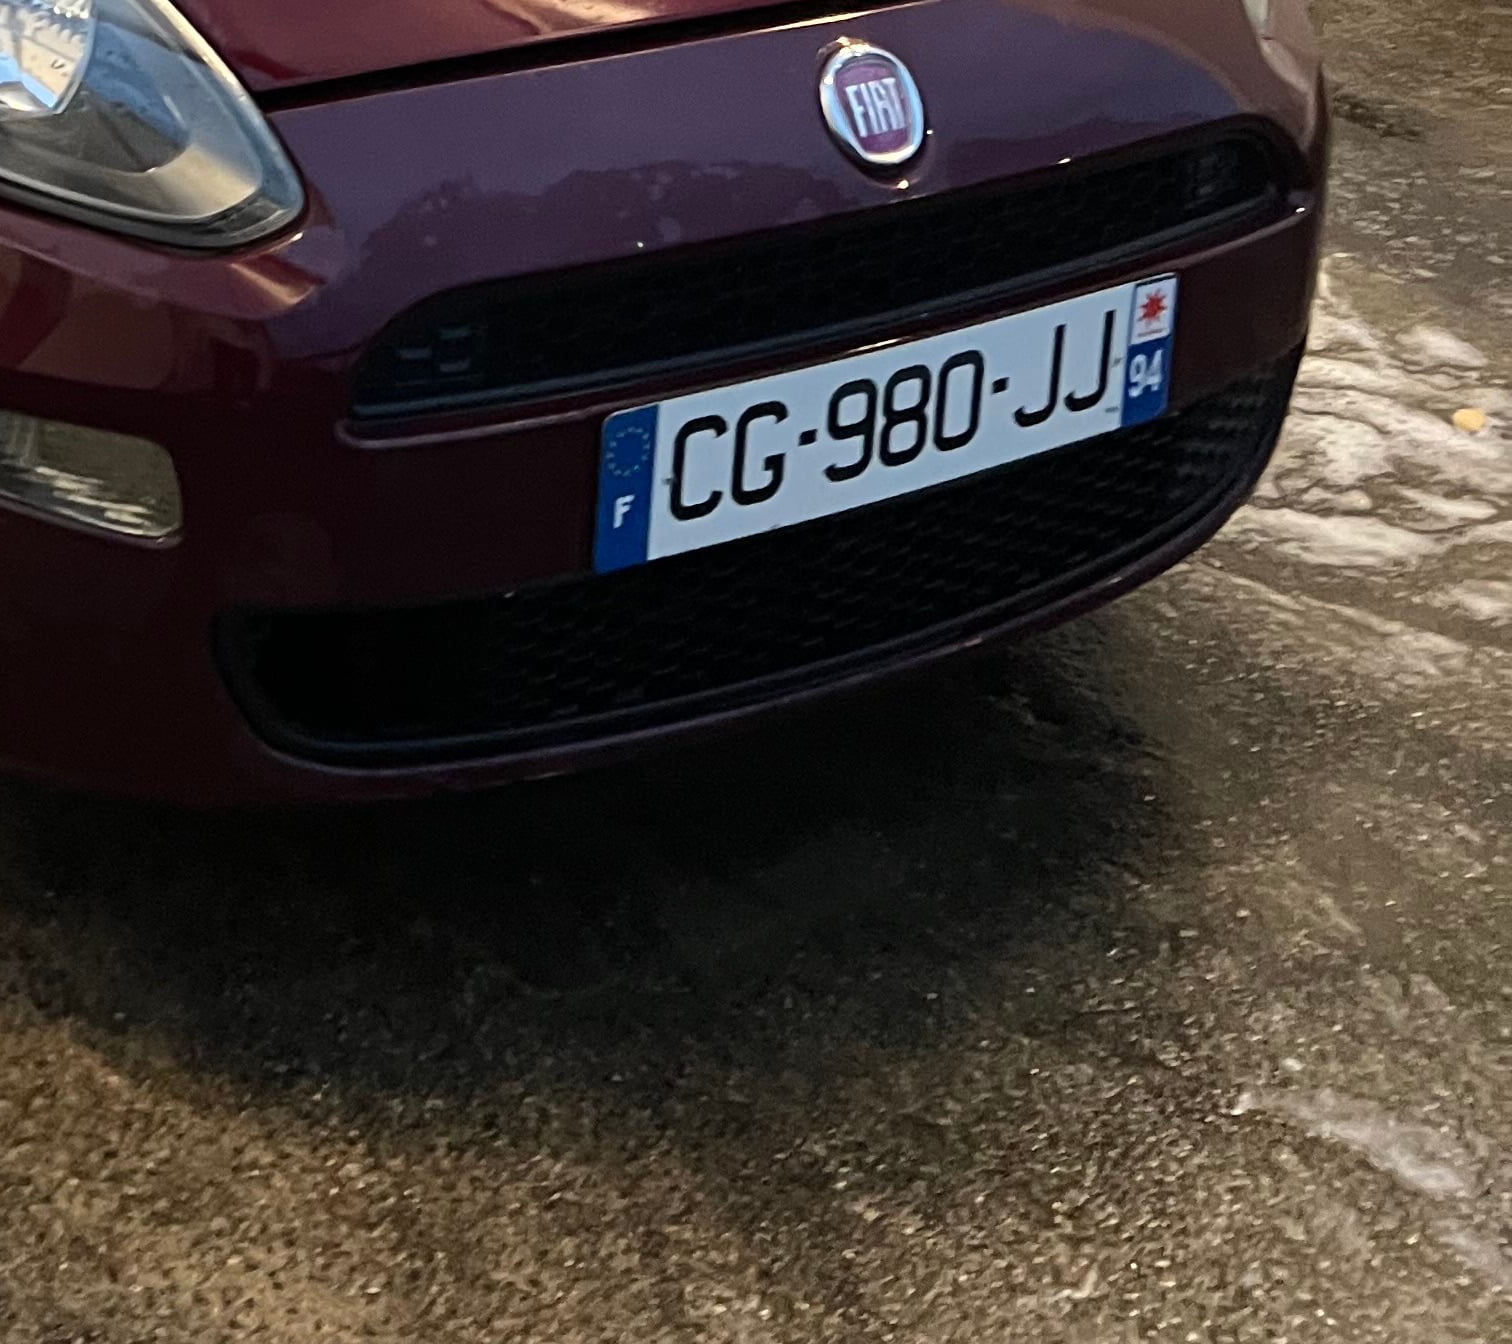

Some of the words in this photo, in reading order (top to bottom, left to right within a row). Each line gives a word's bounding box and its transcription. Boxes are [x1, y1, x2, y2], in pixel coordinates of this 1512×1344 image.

[845, 77, 906, 138] FIAT
[1128, 349, 1164, 398] 94
[668, 309, 1117, 522] CG-980-JJ
[613, 495, 635, 529] F
